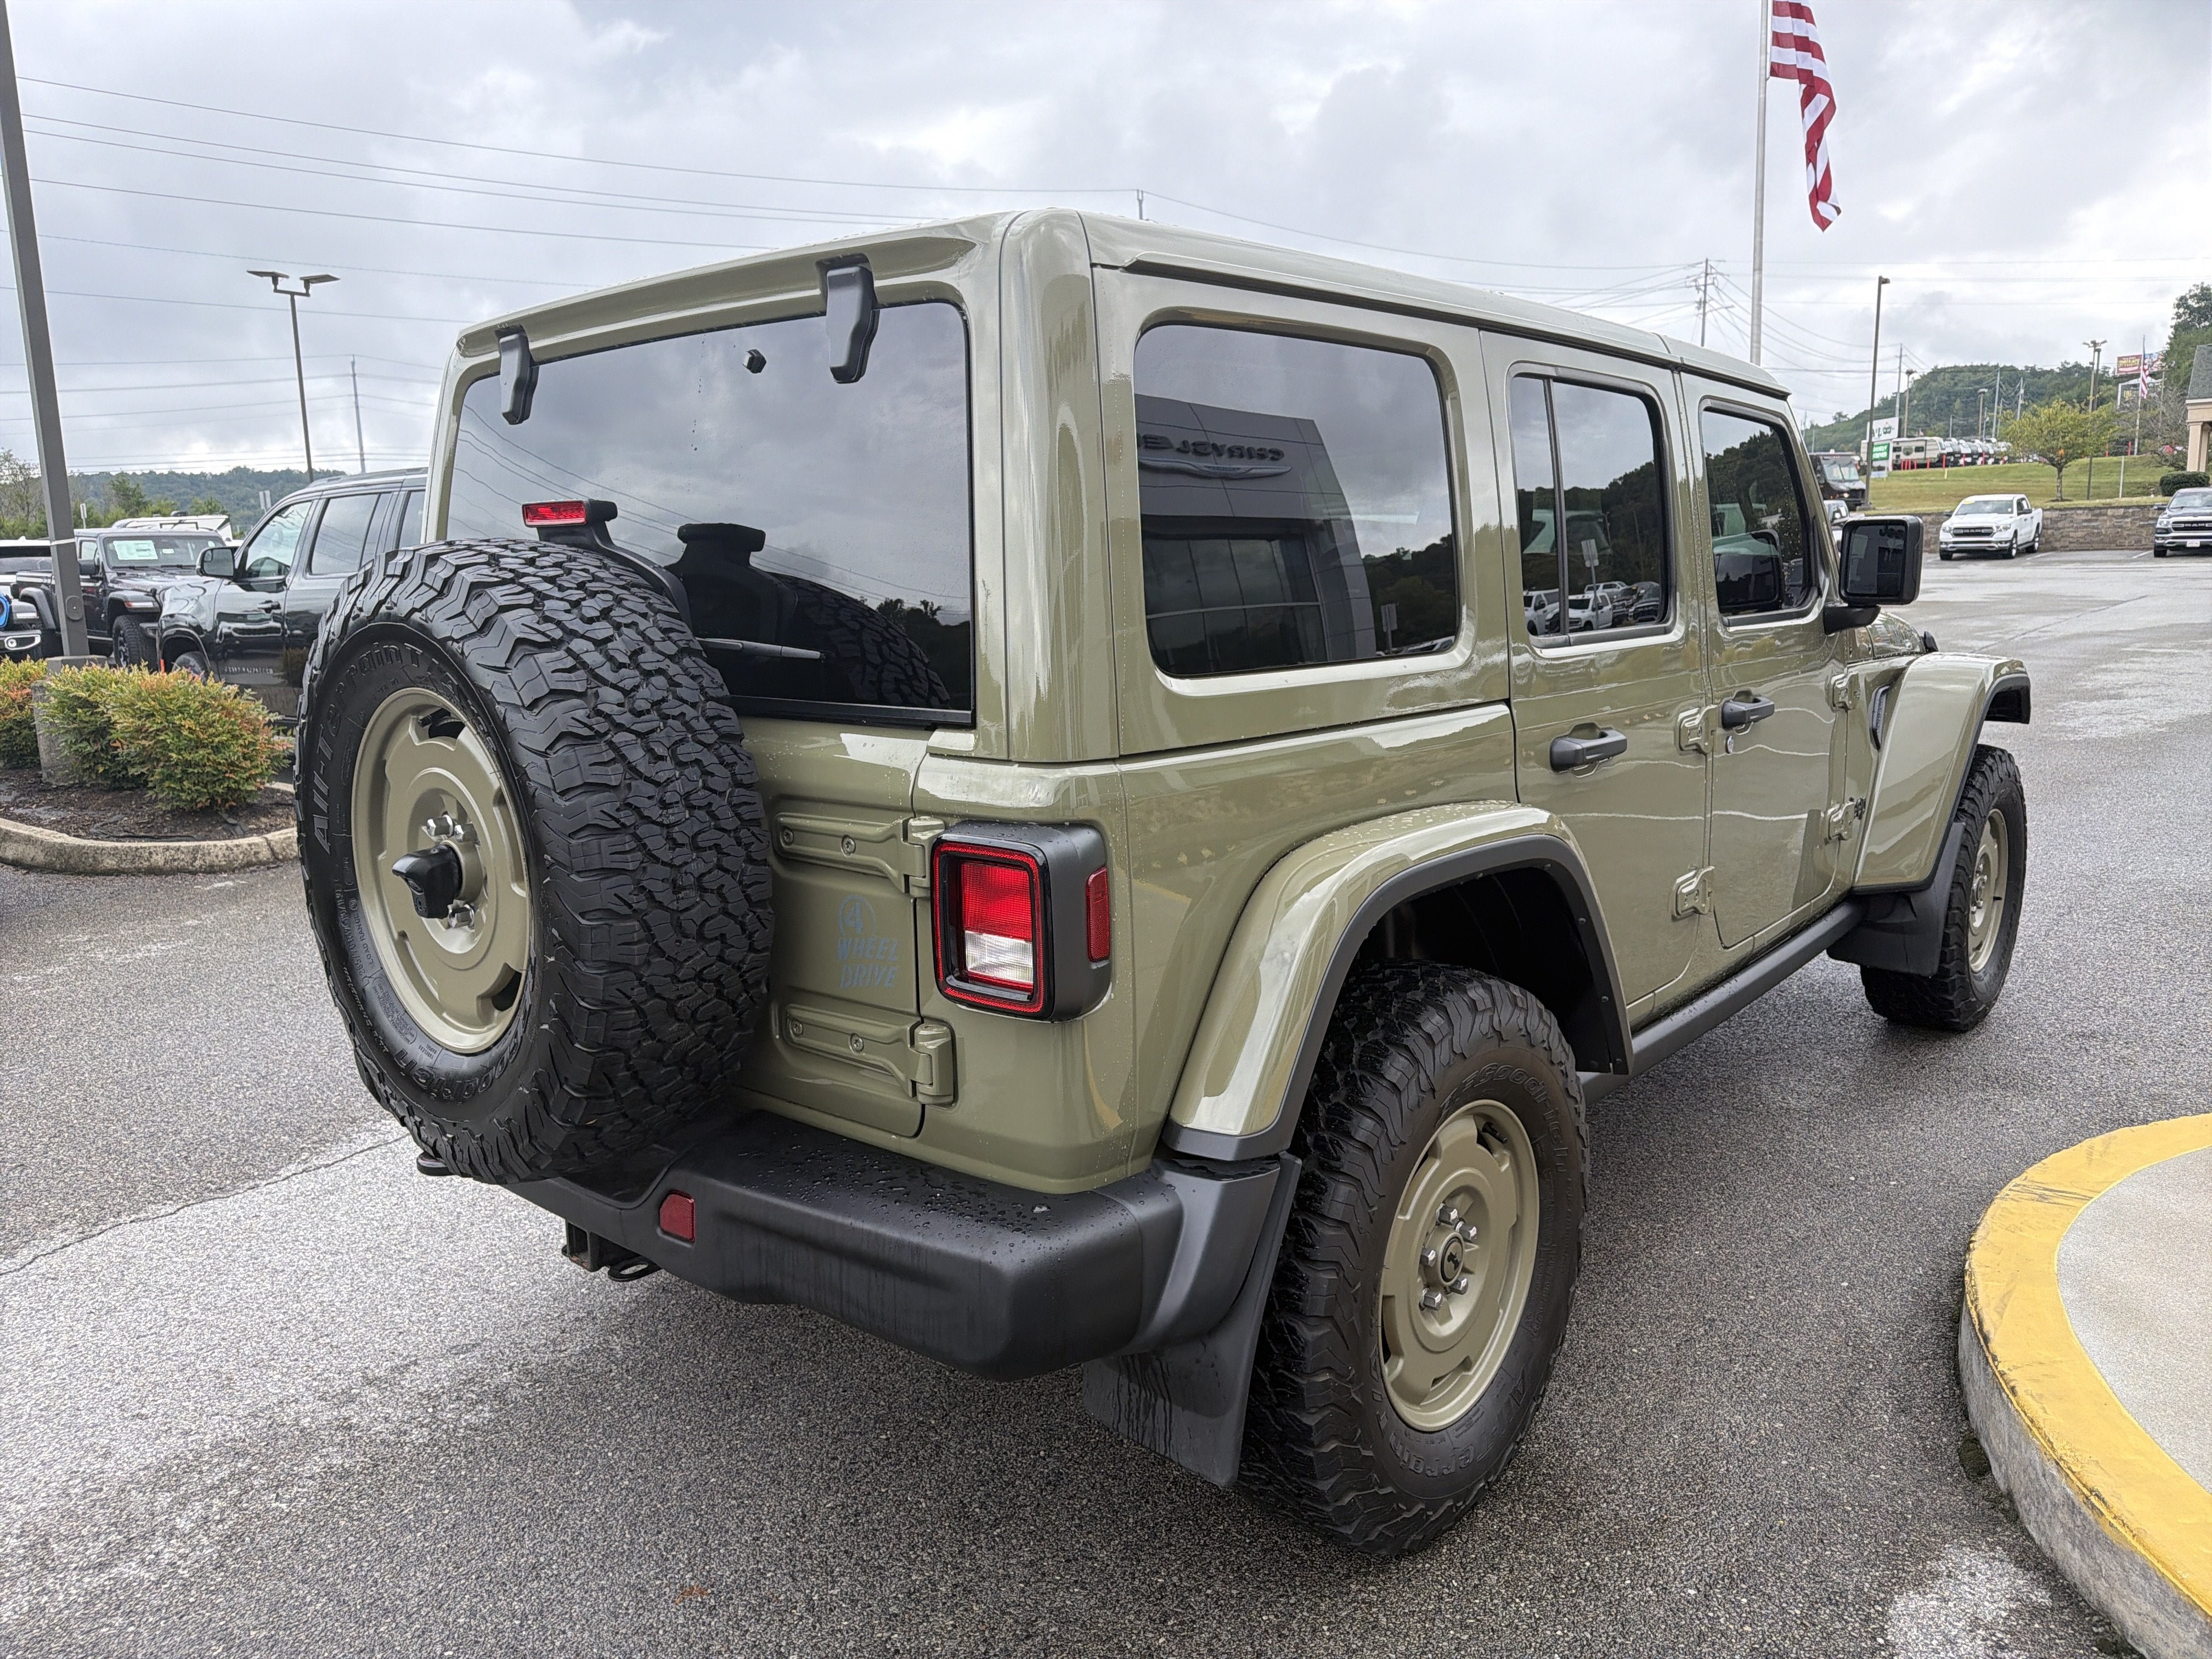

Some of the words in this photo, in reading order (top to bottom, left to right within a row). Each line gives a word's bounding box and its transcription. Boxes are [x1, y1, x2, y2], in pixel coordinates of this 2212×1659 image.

[845, 902, 863, 934] 4
[837, 936, 899, 961] WHEEL
[839, 964, 898, 989] DRIVE
